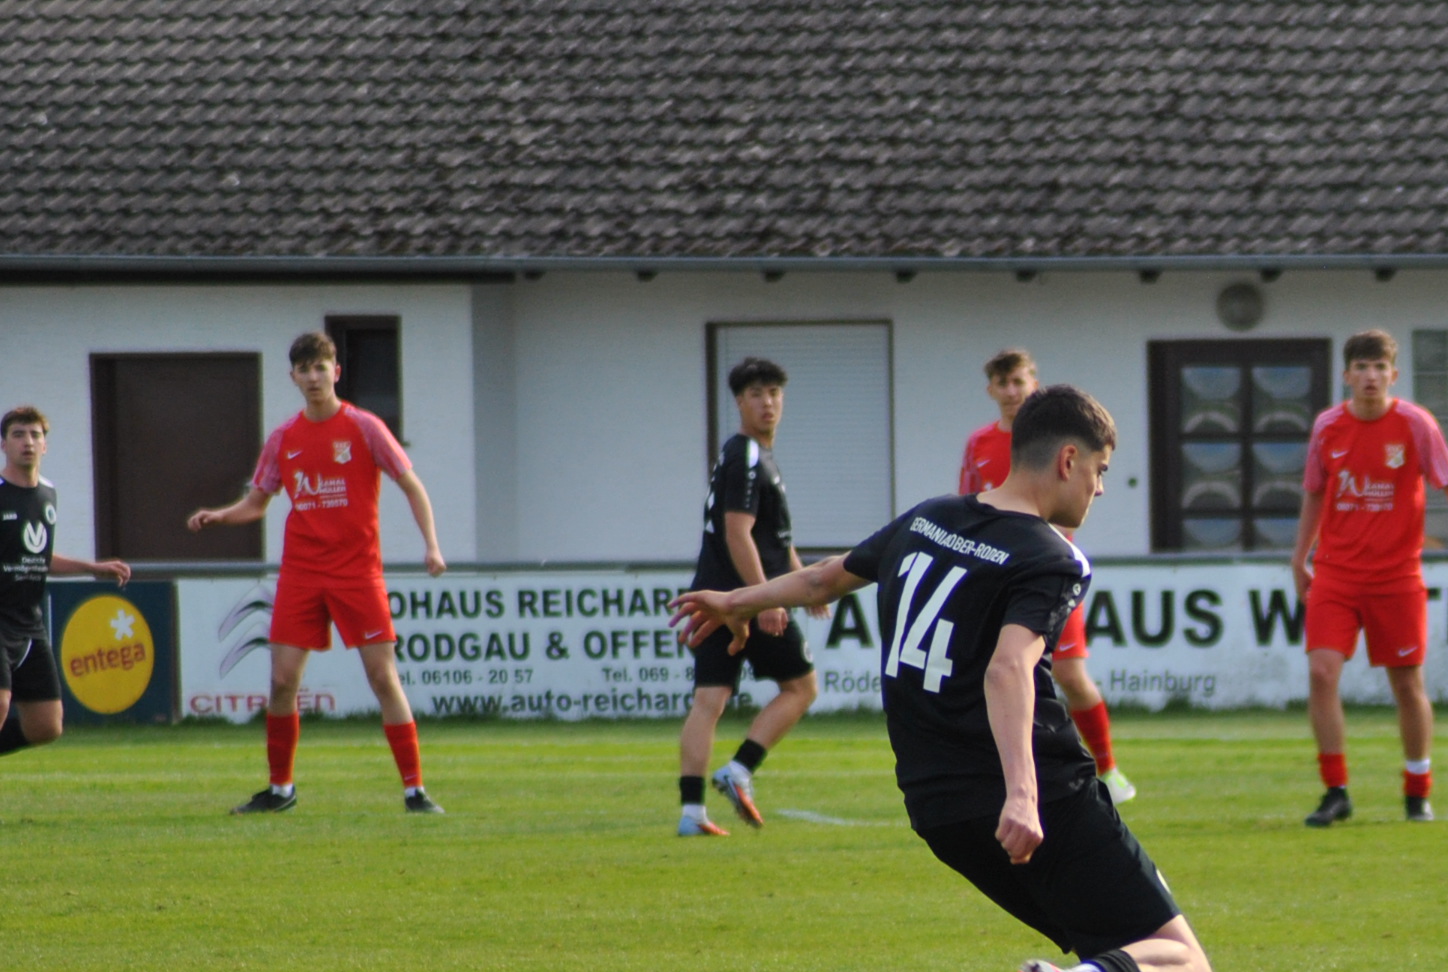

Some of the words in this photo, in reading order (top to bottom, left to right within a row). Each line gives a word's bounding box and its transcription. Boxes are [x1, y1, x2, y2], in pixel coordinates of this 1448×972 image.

[388, 590, 505, 619] OHAUS
[884, 551, 967, 693] 14
[69, 641, 146, 677] entega
[545, 631, 570, 660] &
[422, 669, 473, 684] 06106
[489, 669, 508, 683] 20
[514, 668, 533, 682] 57
[603, 667, 632, 682] Tel.
[638, 667, 669, 681] 069
[824, 669, 882, 693] Röde
[1110, 669, 1217, 697] Hainburg
[190, 689, 336, 714] CITRËN
